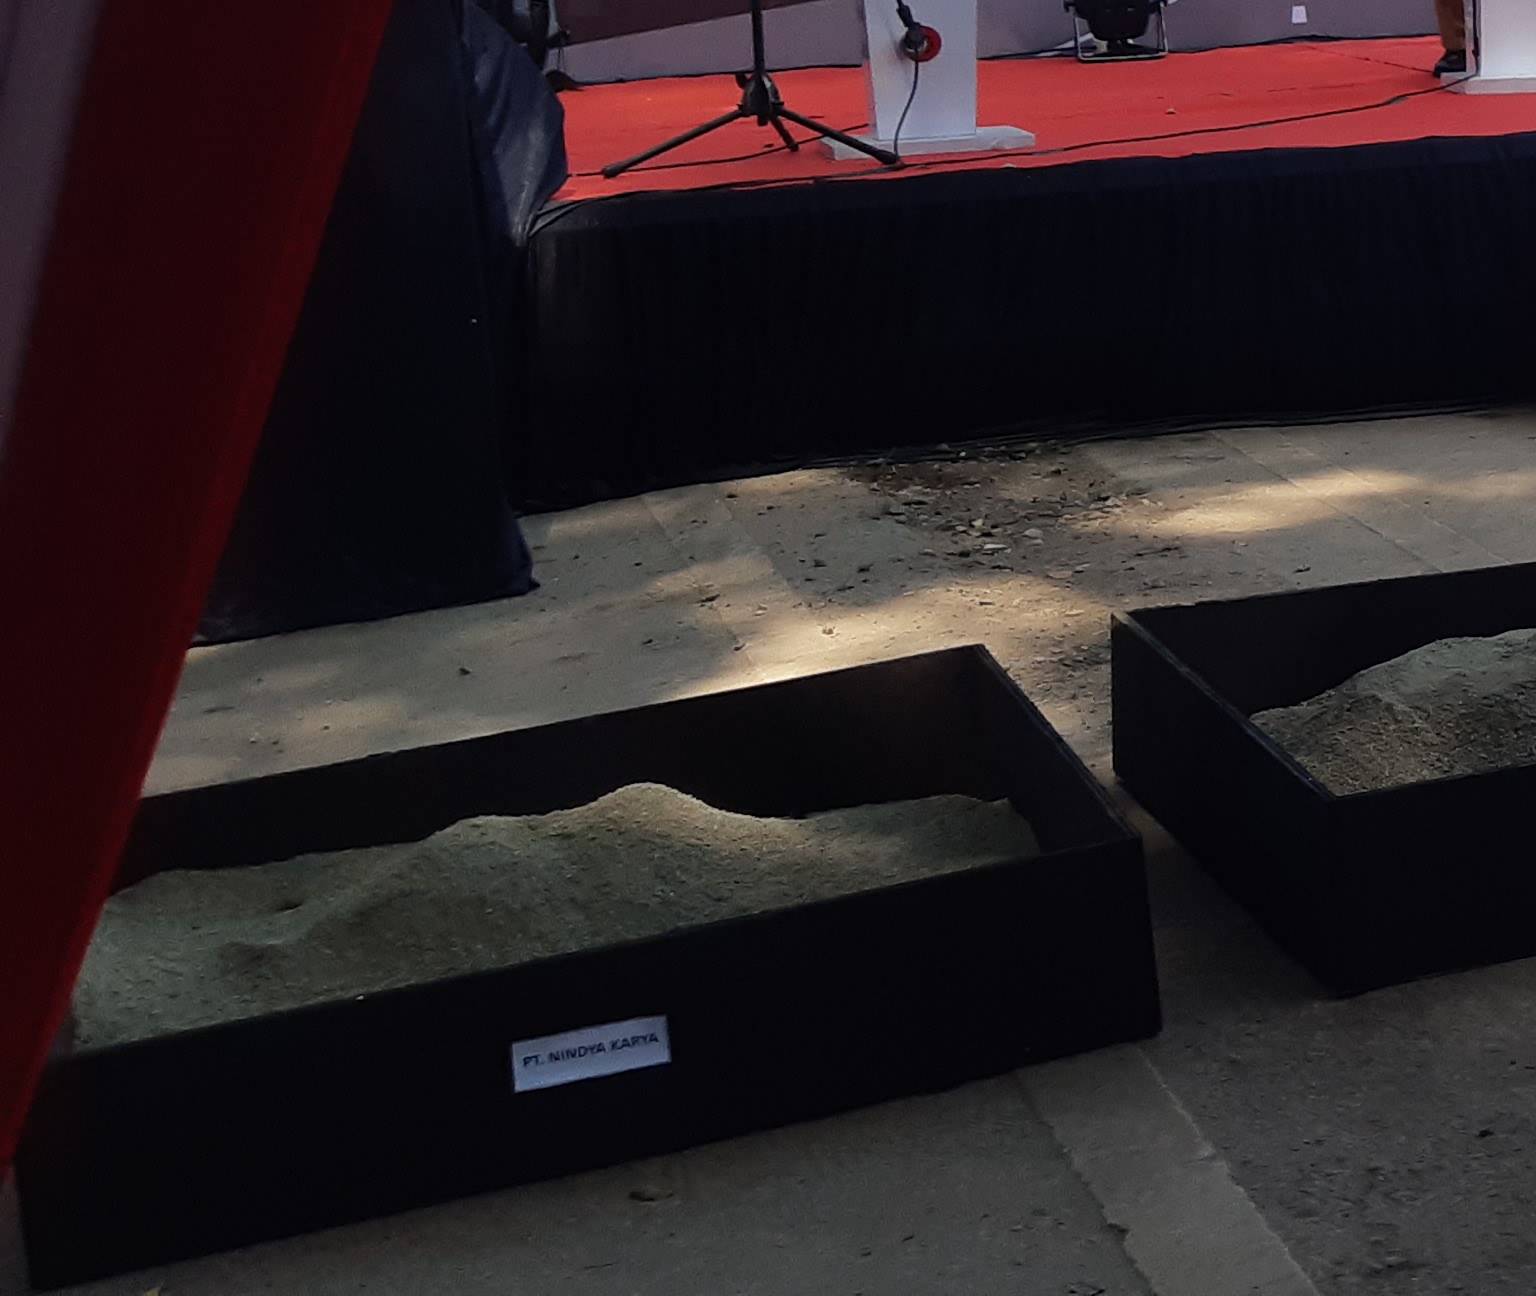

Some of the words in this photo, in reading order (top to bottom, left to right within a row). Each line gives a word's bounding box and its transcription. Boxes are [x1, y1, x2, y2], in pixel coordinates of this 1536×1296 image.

[523, 1055, 544, 1067] PT.
[549, 1042, 606, 1061] NINDYA
[610, 1033, 658, 1050] KARYA
